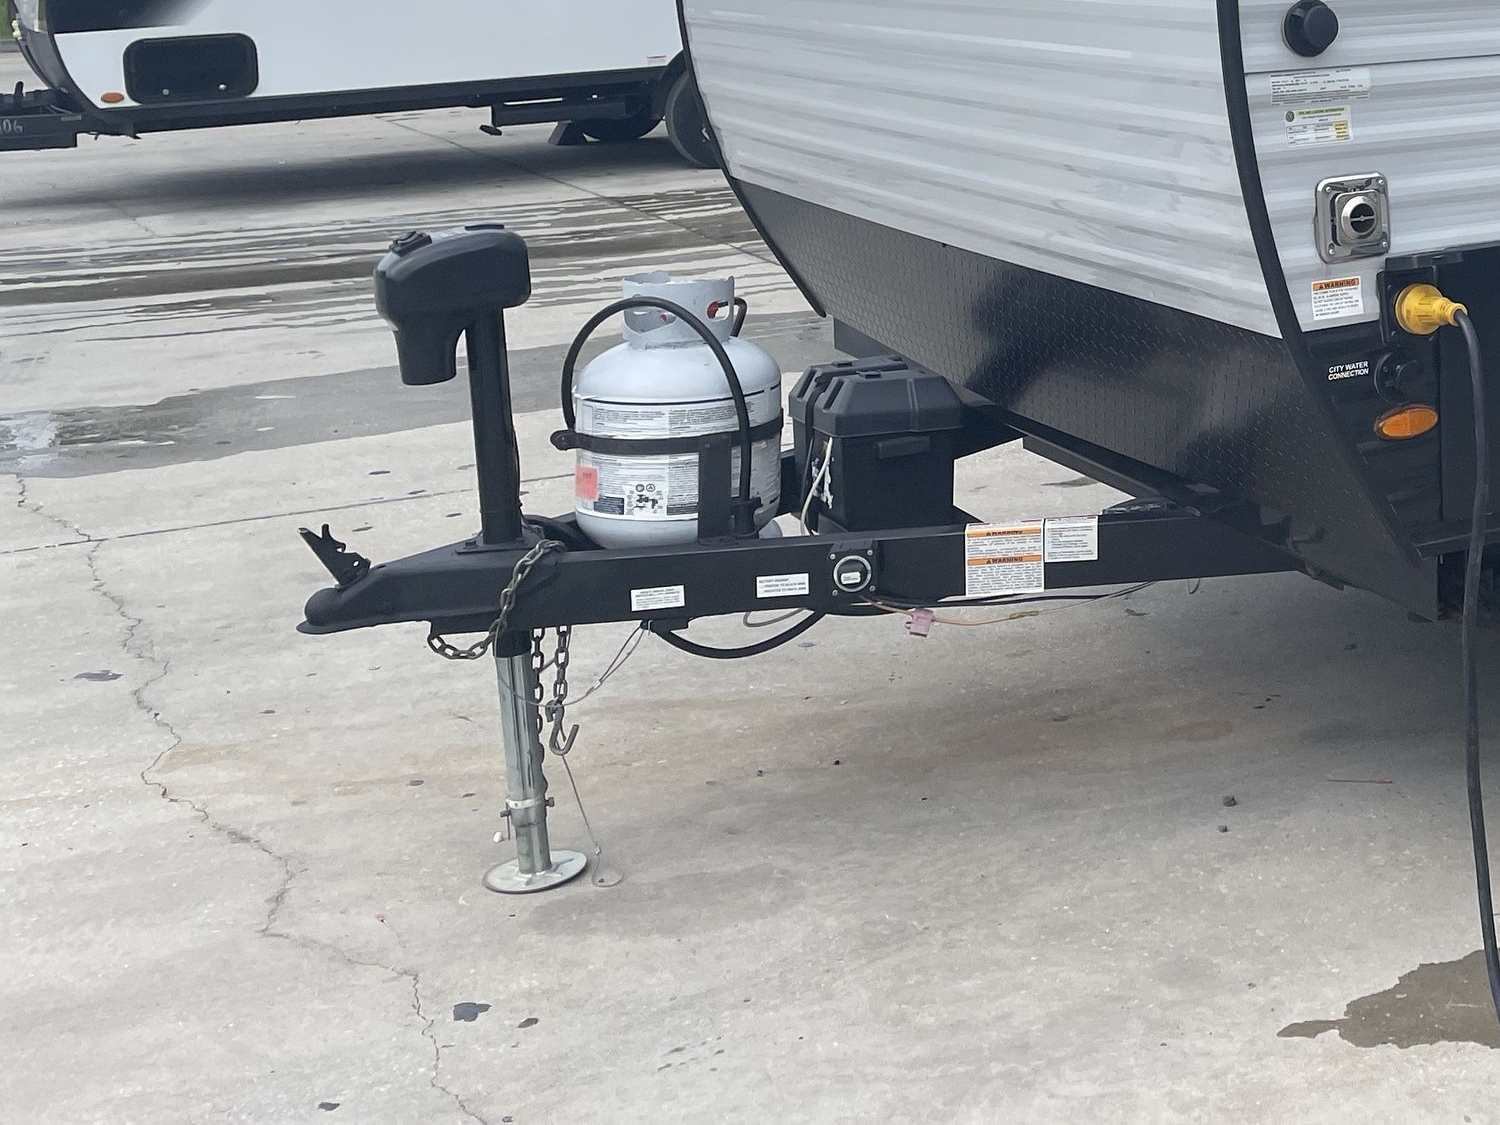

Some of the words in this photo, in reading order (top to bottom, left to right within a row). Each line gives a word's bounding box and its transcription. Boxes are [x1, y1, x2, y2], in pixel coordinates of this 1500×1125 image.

[1324, 278, 1356, 289] WARNING
[1328, 365, 1344, 373] CITY
[1345, 361, 1369, 371] WATER
[1328, 367, 1369, 380] CONNECTION
[992, 556, 1024, 564] WARNING
